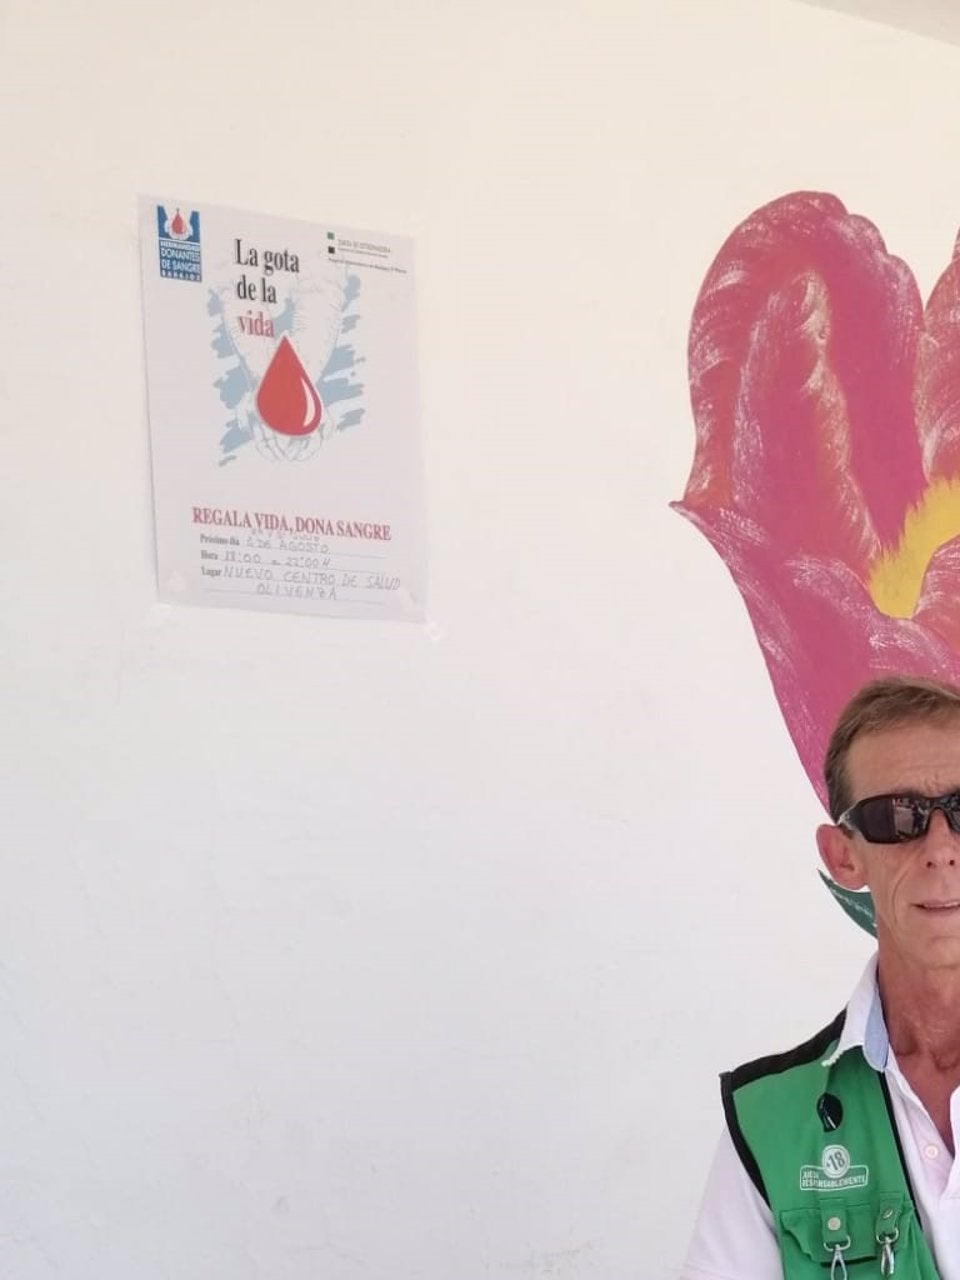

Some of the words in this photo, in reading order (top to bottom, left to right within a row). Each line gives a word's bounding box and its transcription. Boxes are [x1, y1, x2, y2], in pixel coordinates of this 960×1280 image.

[234, 238, 259, 267] La
[264, 248, 300, 276] gota
[236, 274, 257, 302] de
[262, 277, 277, 304] la
[238, 310, 275, 338] vida
[192, 506, 252, 528] REGALA
[253, 512, 294, 534] VIDA,
[295, 516, 335, 537] DONA
[336, 519, 392, 541] SANGRE
[224, 565, 274, 581] NUEVO
[283, 570, 336, 586] CENTRO
